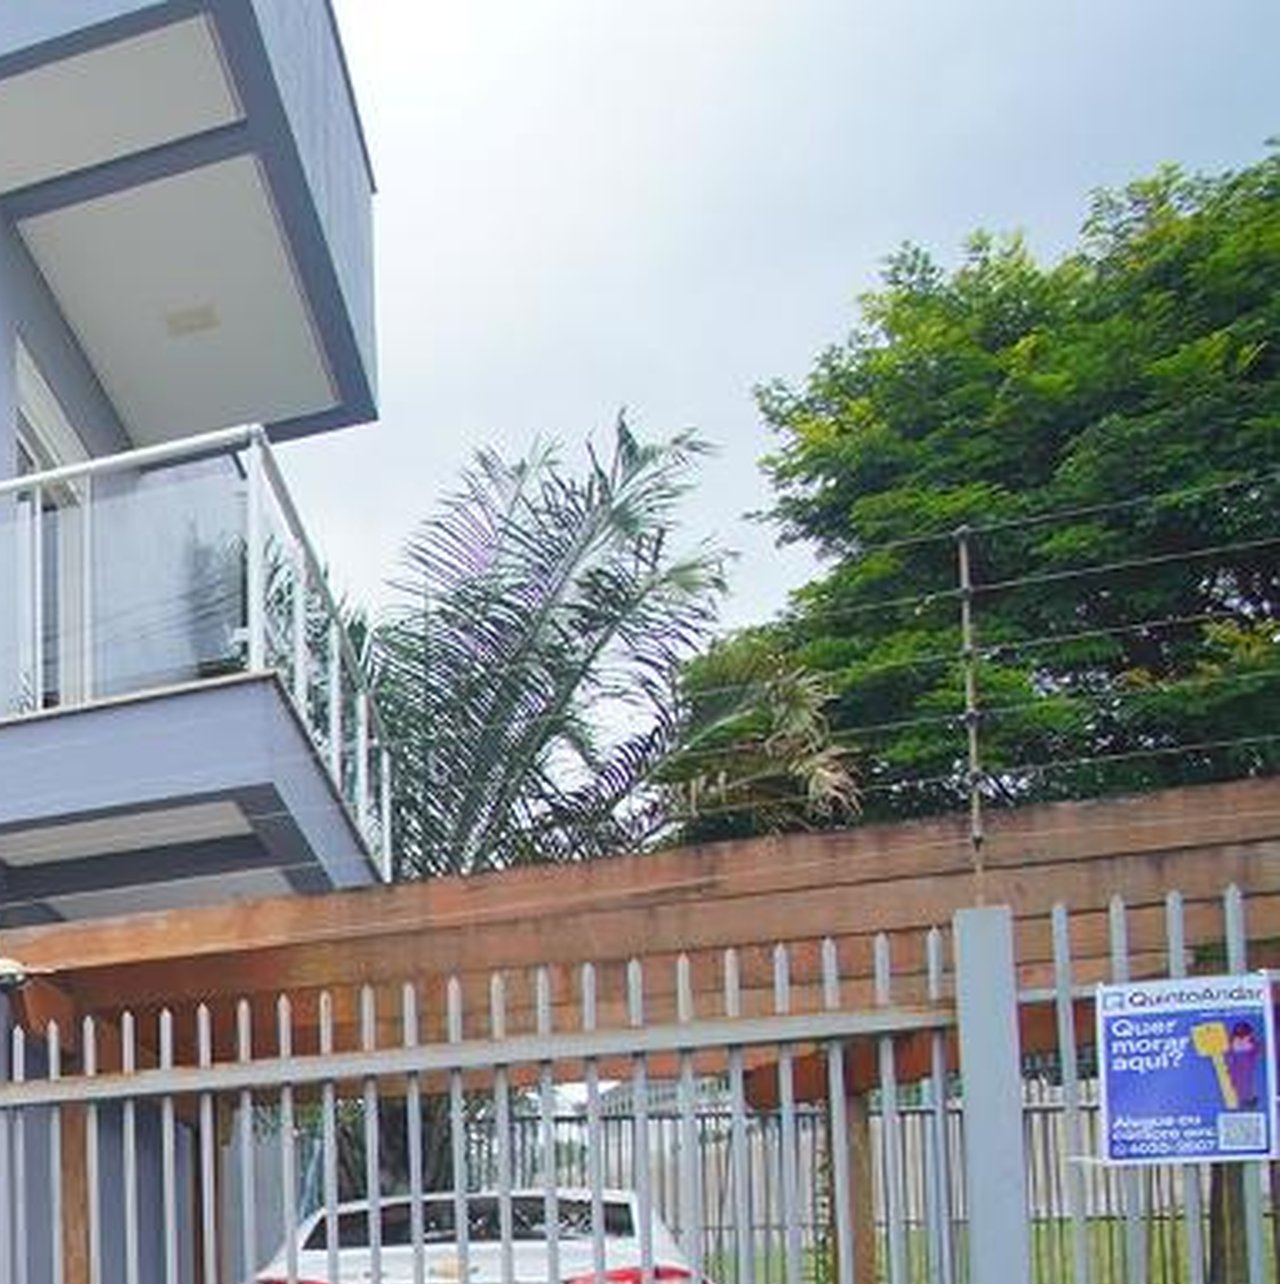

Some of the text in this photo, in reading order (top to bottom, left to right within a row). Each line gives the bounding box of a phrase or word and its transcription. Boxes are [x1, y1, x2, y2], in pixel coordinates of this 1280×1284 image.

[1129, 986, 1264, 1007] QuintoAndar
[1111, 1018, 1178, 1037] Quer
[1111, 1035, 1190, 1054] morar
[1111, 1049, 1184, 1073] aqui?
